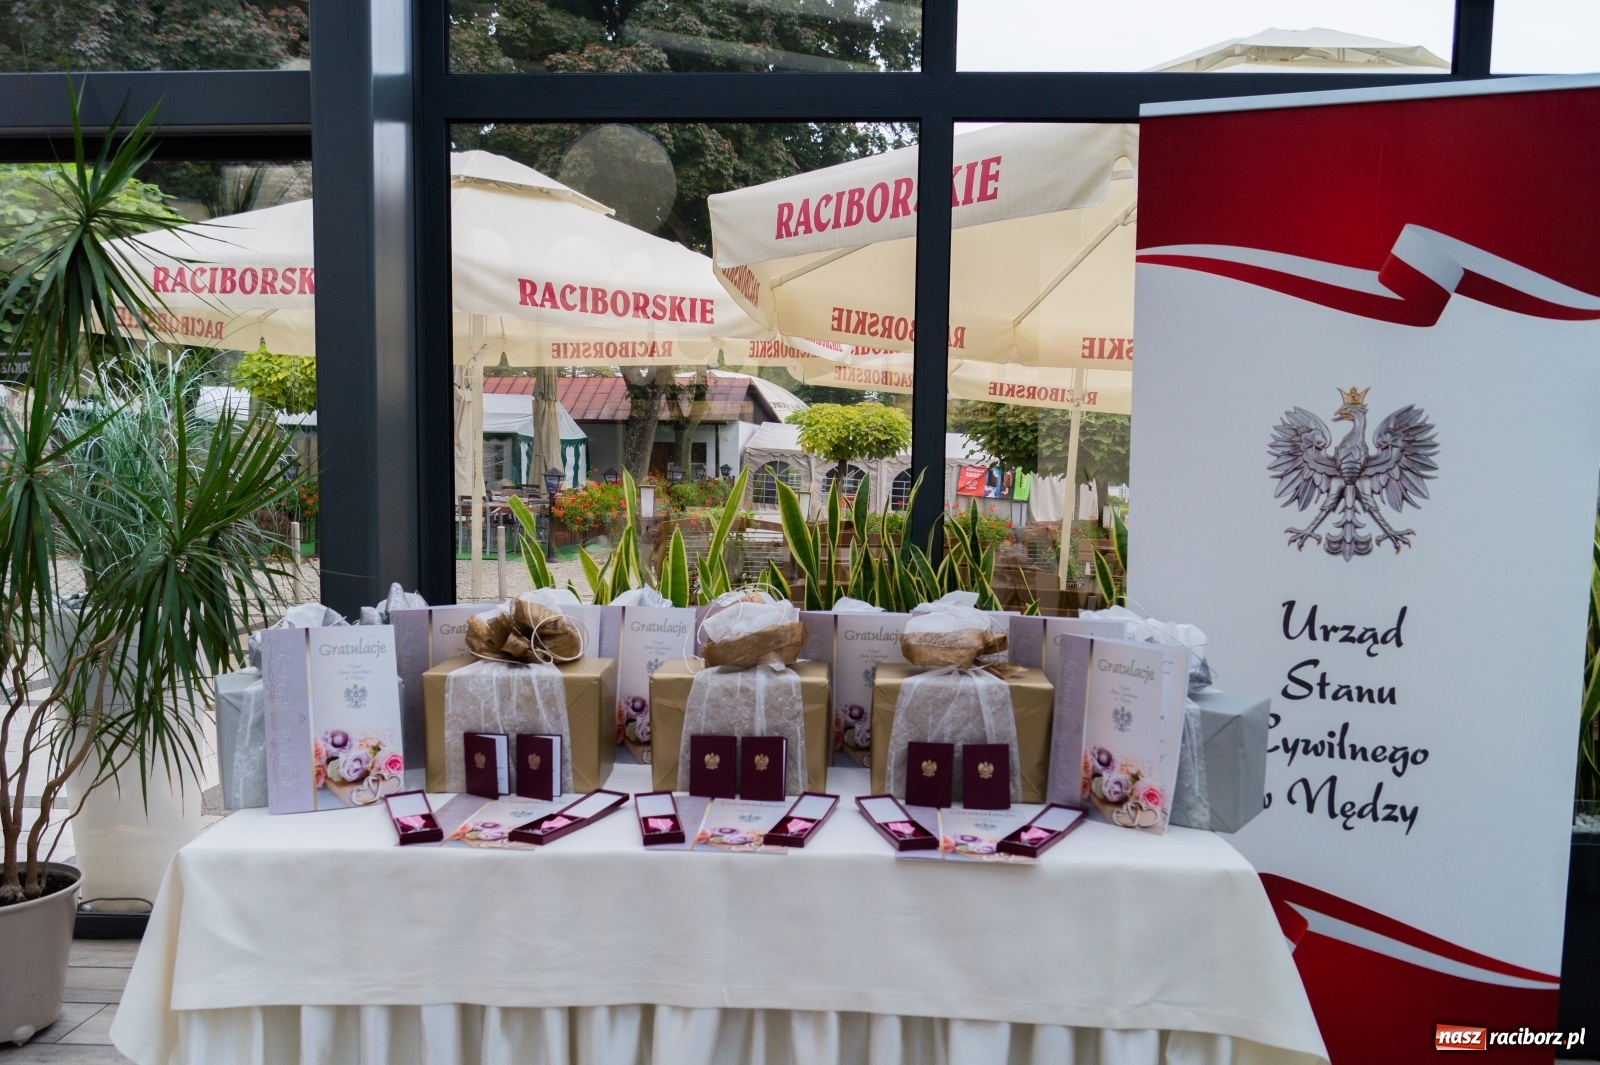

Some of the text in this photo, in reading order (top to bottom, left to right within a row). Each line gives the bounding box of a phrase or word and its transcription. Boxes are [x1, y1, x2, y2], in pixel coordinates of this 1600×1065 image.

[518, 278, 714, 324] RACIBORSKIE
[318, 638, 387, 658] Gratulacje
[631, 618, 687, 637] Gratulacje
[1281, 600, 1407, 657] Urząd
[1098, 659, 1155, 684] Gratulacje
[1281, 659, 1397, 705] Stanu
[1287, 775, 1419, 836] Nędzy
